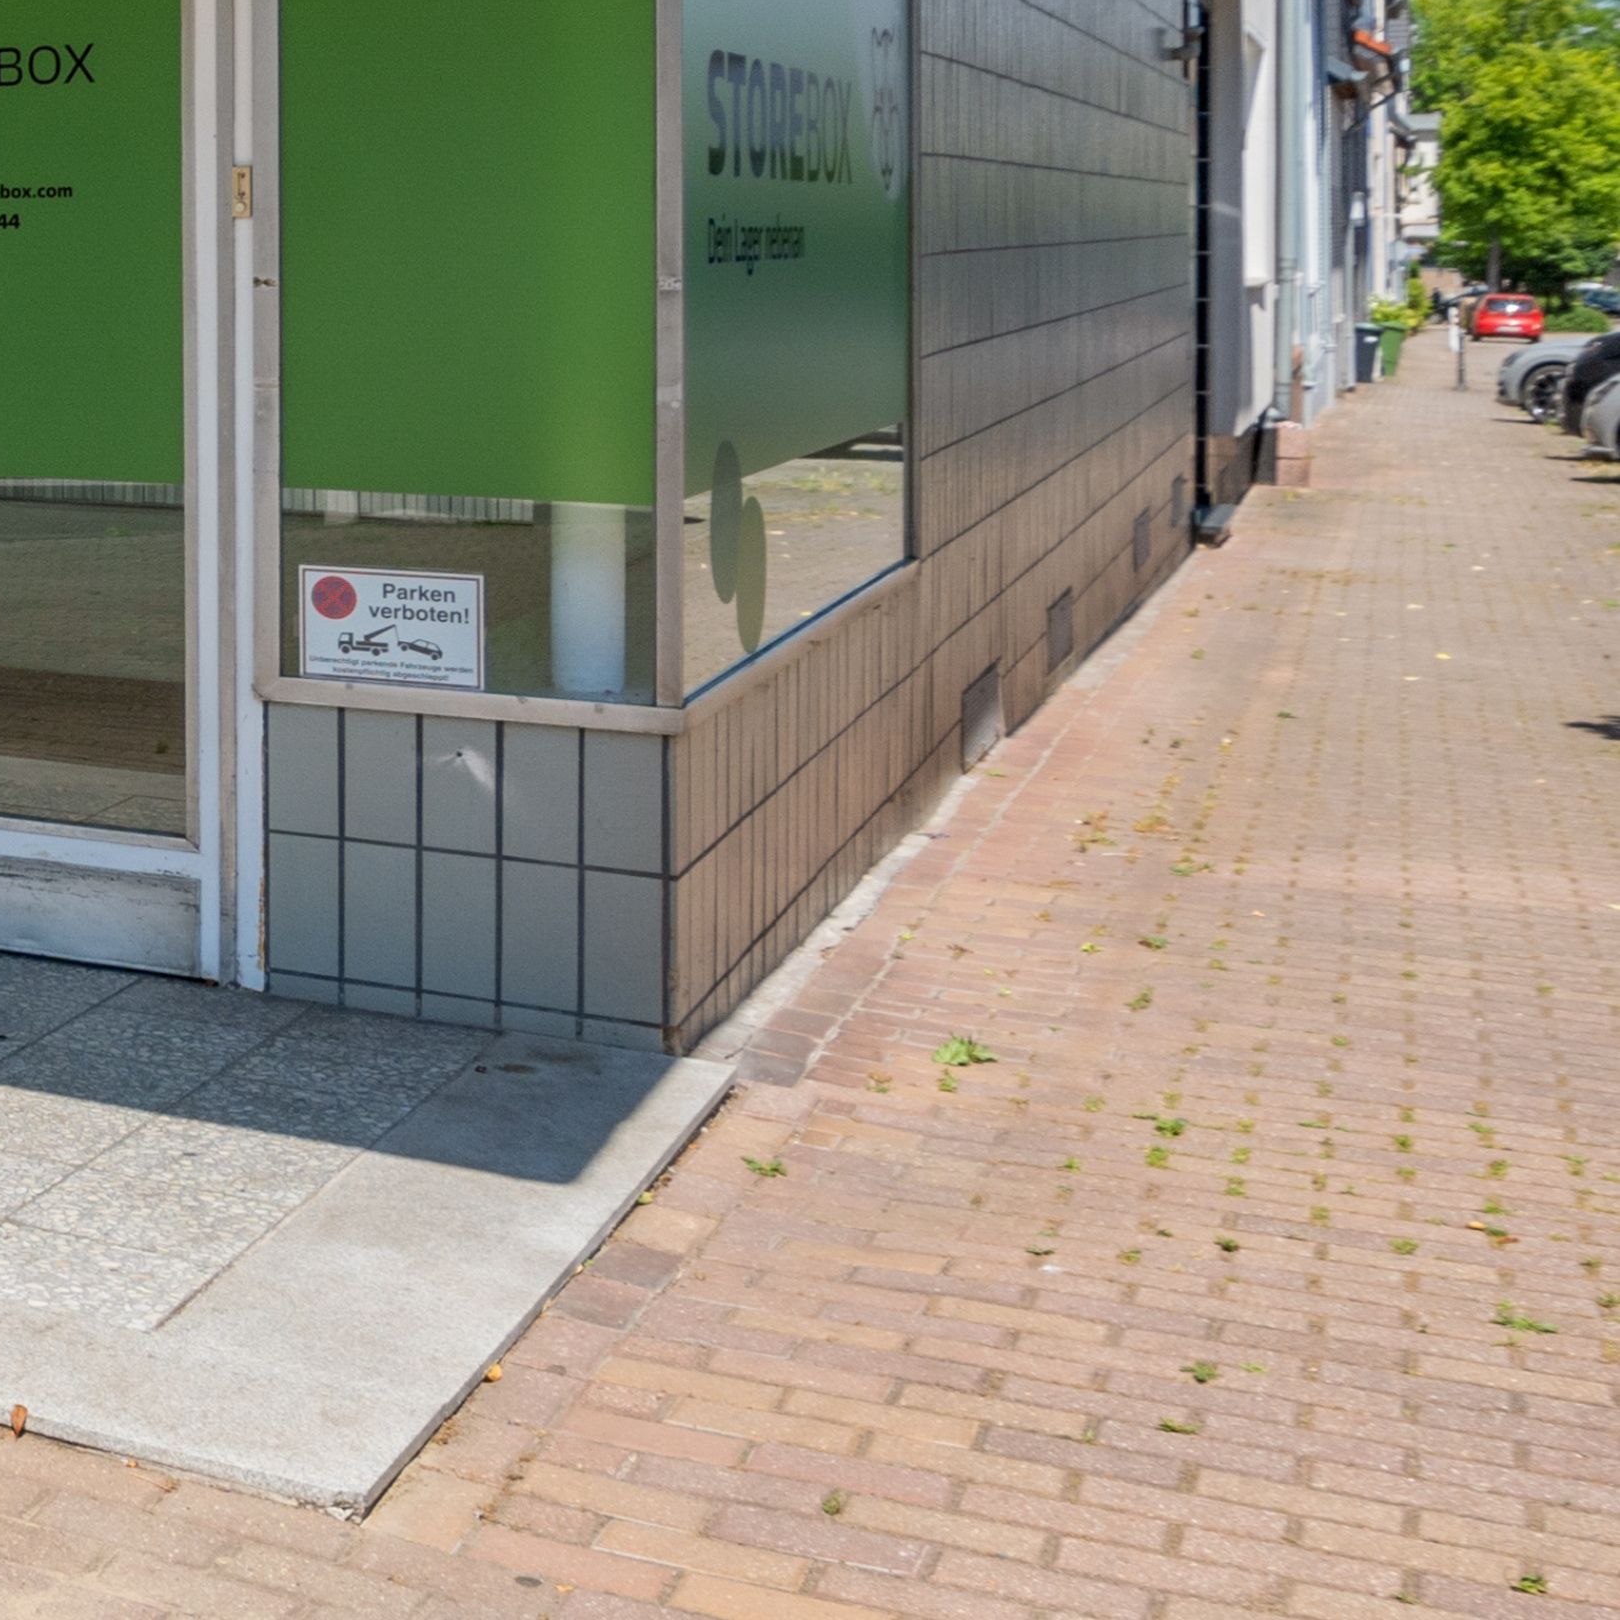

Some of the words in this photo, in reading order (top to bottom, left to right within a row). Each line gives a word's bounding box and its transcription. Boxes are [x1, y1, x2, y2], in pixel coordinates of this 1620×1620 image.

[707, 49, 852, 184] STOREBOX
[382, 583, 456, 603] Parken
[368, 604, 469, 624] verboten!
